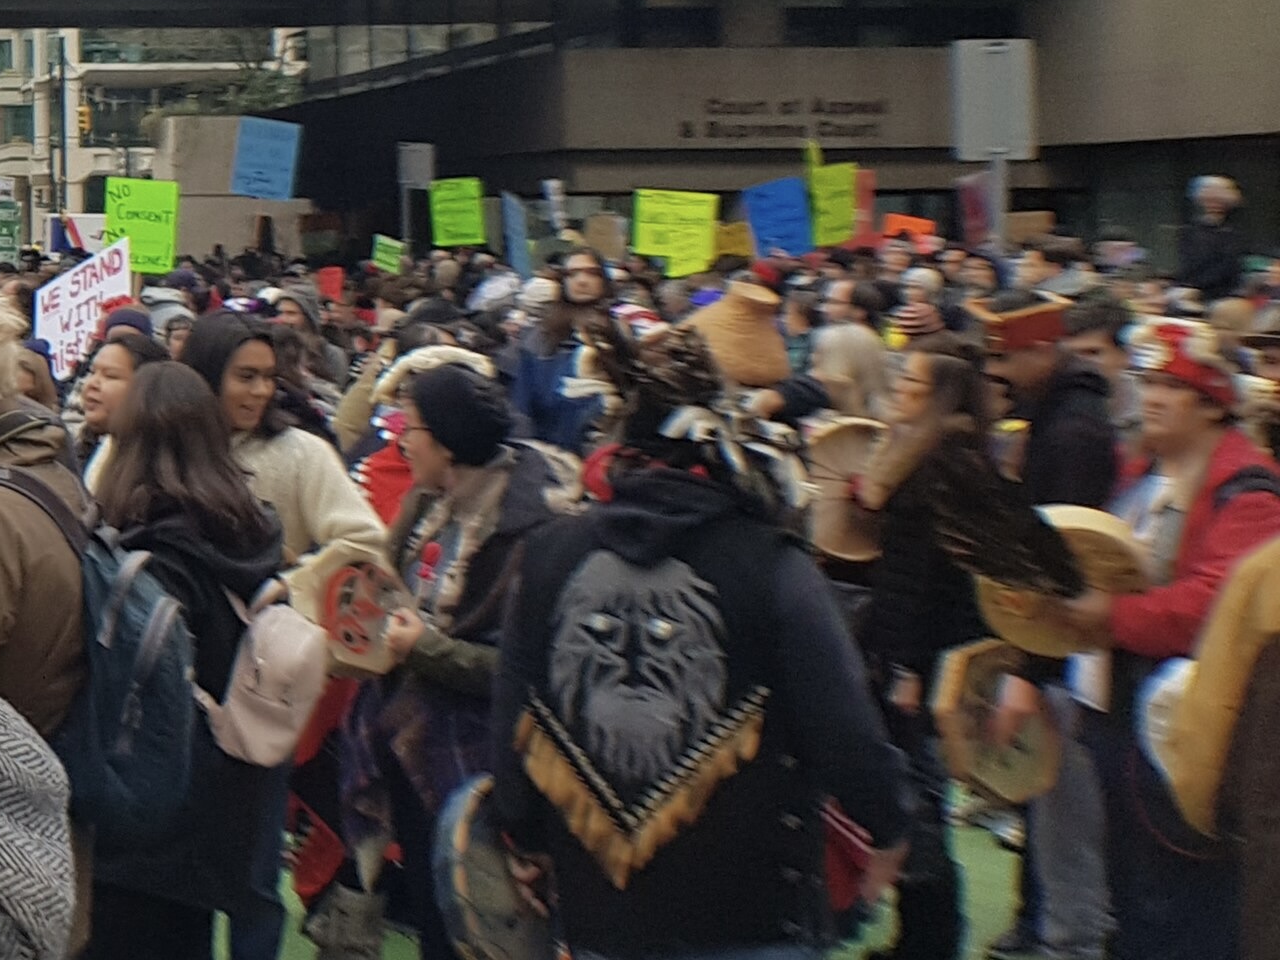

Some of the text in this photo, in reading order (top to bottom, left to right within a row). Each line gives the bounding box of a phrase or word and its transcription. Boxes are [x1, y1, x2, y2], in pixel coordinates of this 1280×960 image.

[108, 184, 131, 203] NO
[40, 286, 61, 315] WE
[69, 248, 124, 299] STAND
